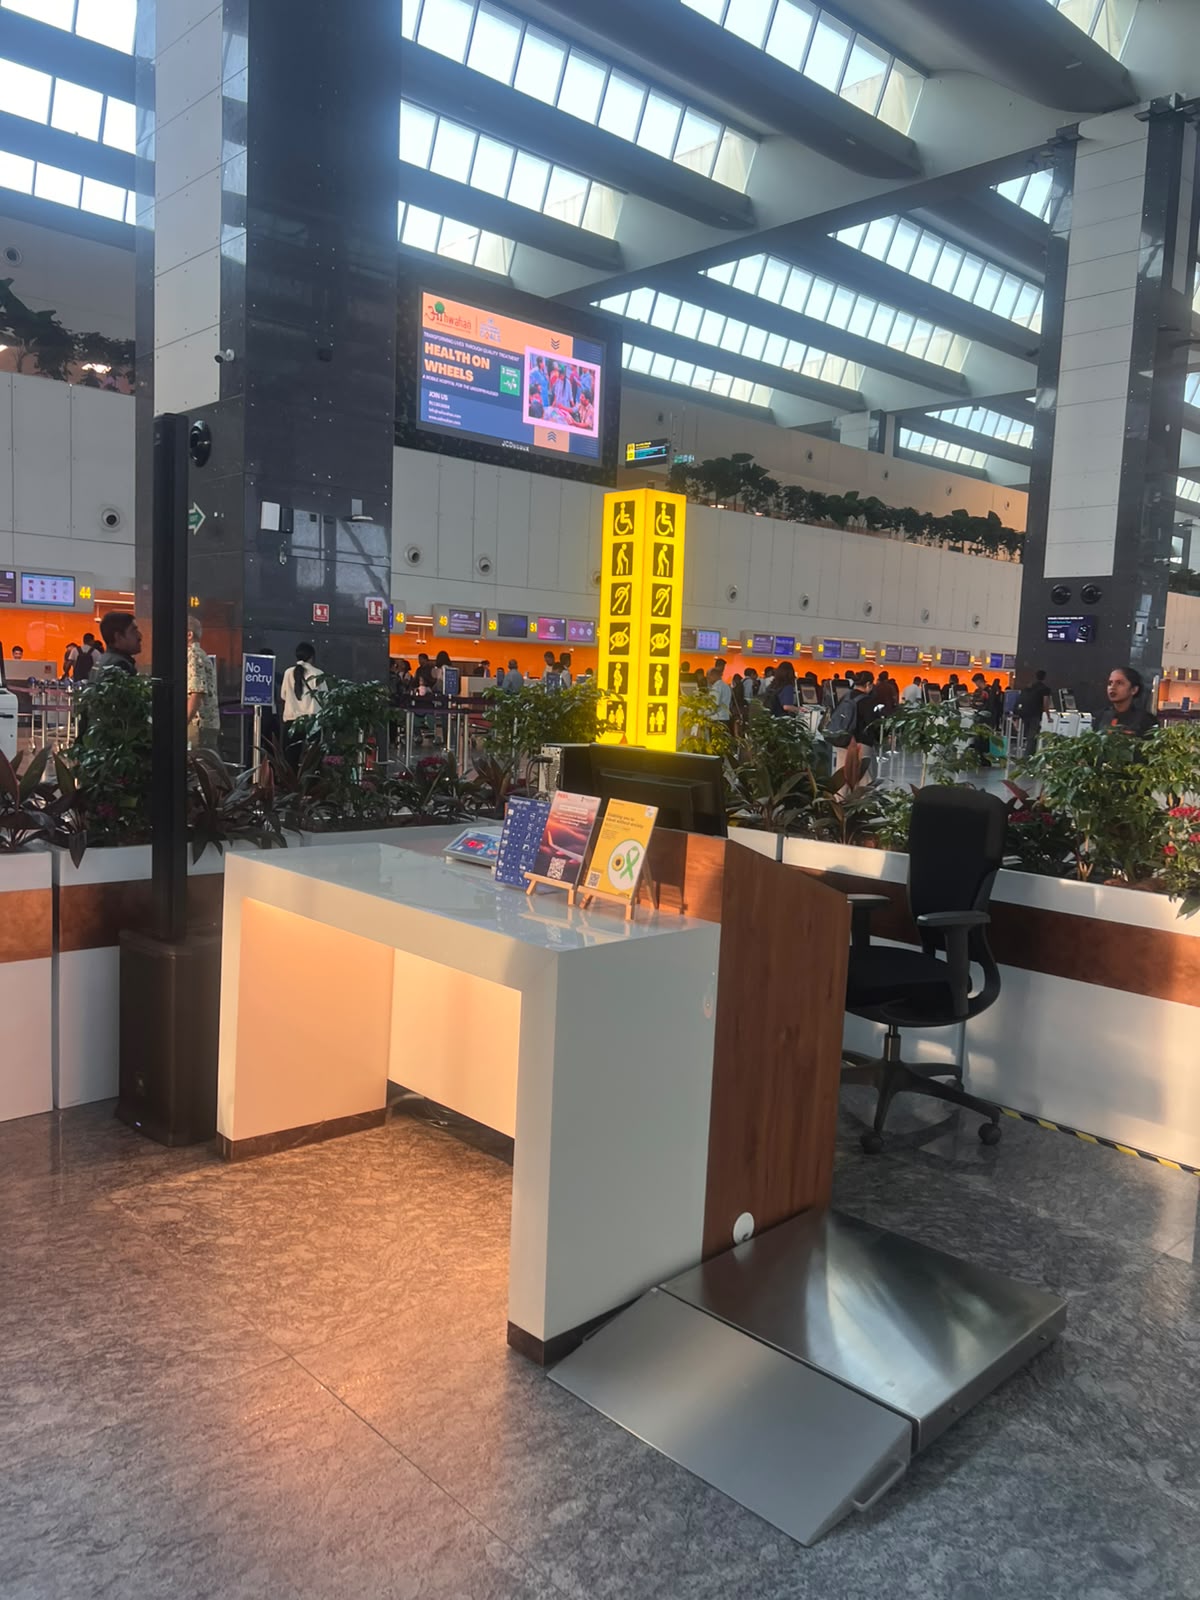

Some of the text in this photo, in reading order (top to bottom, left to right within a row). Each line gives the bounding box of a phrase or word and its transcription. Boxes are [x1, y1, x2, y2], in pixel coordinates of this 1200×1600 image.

[424, 341, 489, 370] HEALTH ON
[424, 358, 473, 382] WHEELS
[428, 390, 440, 399] JOIN
[79, 586, 91, 599] 44
[488, 619, 497, 631] 50
[245, 661, 261, 673] No
[245, 673, 272, 686] entry
